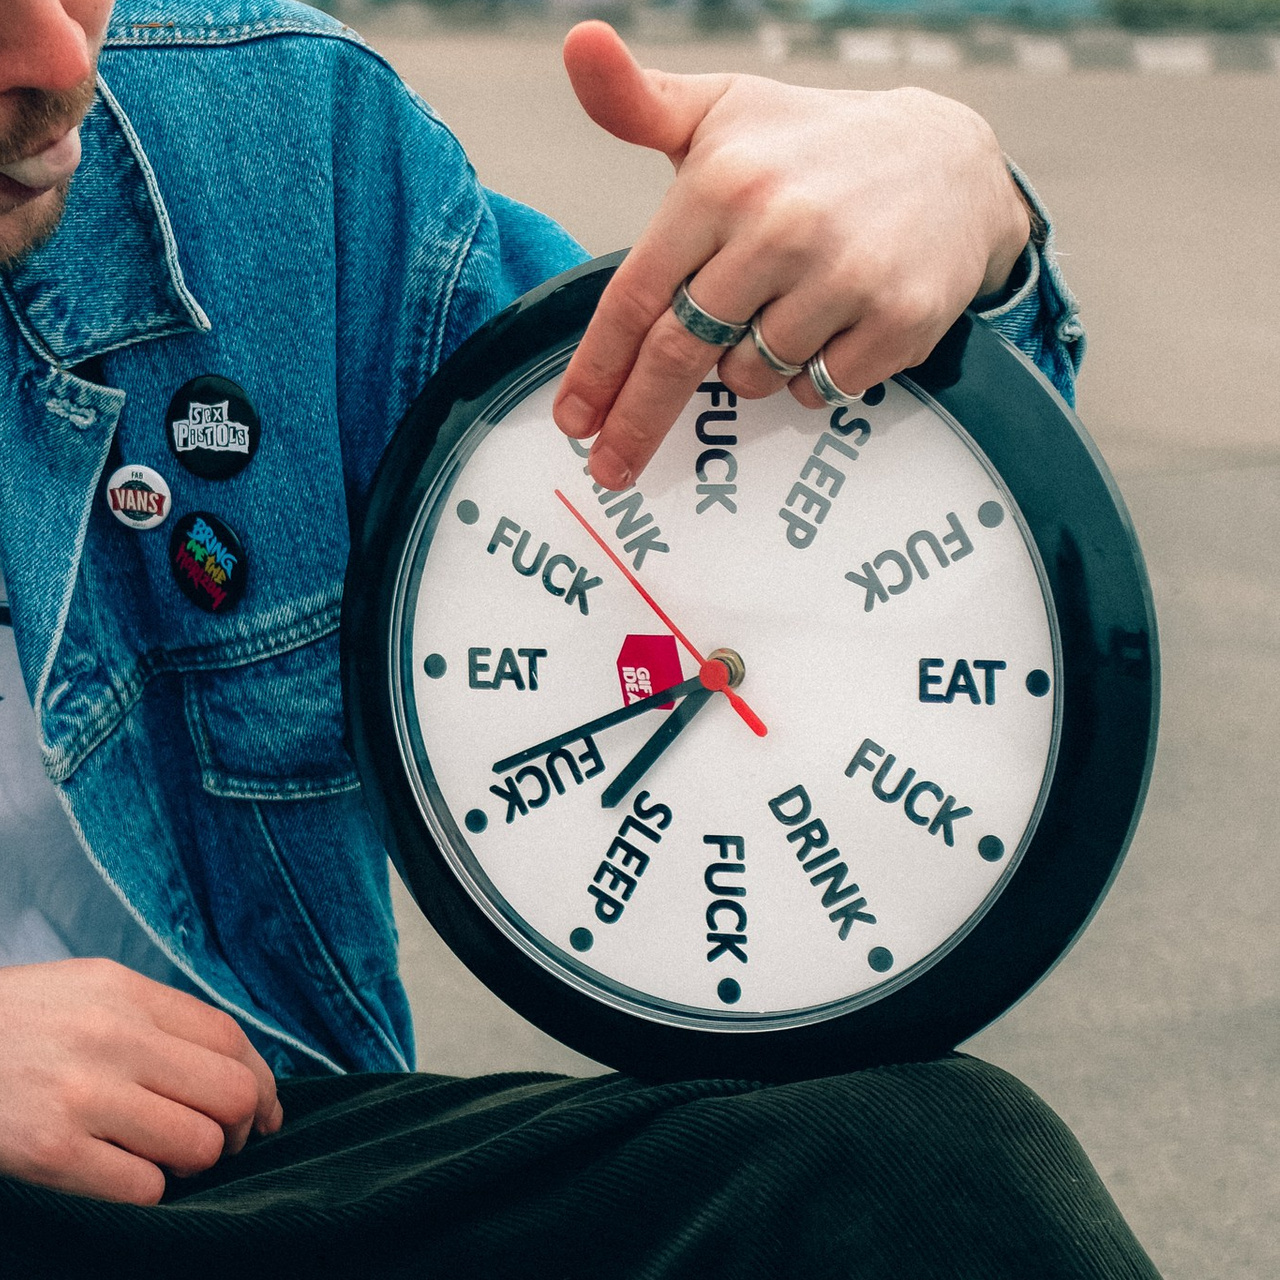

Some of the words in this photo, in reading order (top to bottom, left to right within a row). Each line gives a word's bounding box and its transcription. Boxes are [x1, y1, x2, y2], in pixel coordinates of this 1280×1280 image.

[695, 381, 738, 516] FUCK
[778, 406, 872, 550] SLEEP
[115, 489, 160, 515] VANS
[186, 517, 238, 580] BRING
[567, 436, 670, 572] INK
[487, 516, 604, 617] FUCK
[844, 511, 974, 613] FUCK
[467, 646, 548, 692] EAT
[917, 657, 1007, 706] EAT
[489, 734, 606, 825] FUCK
[844, 738, 974, 848] FUCK
[586, 789, 673, 925] SLEEP
[702, 834, 749, 964] FUCK
[767, 784, 877, 942] DRINK
